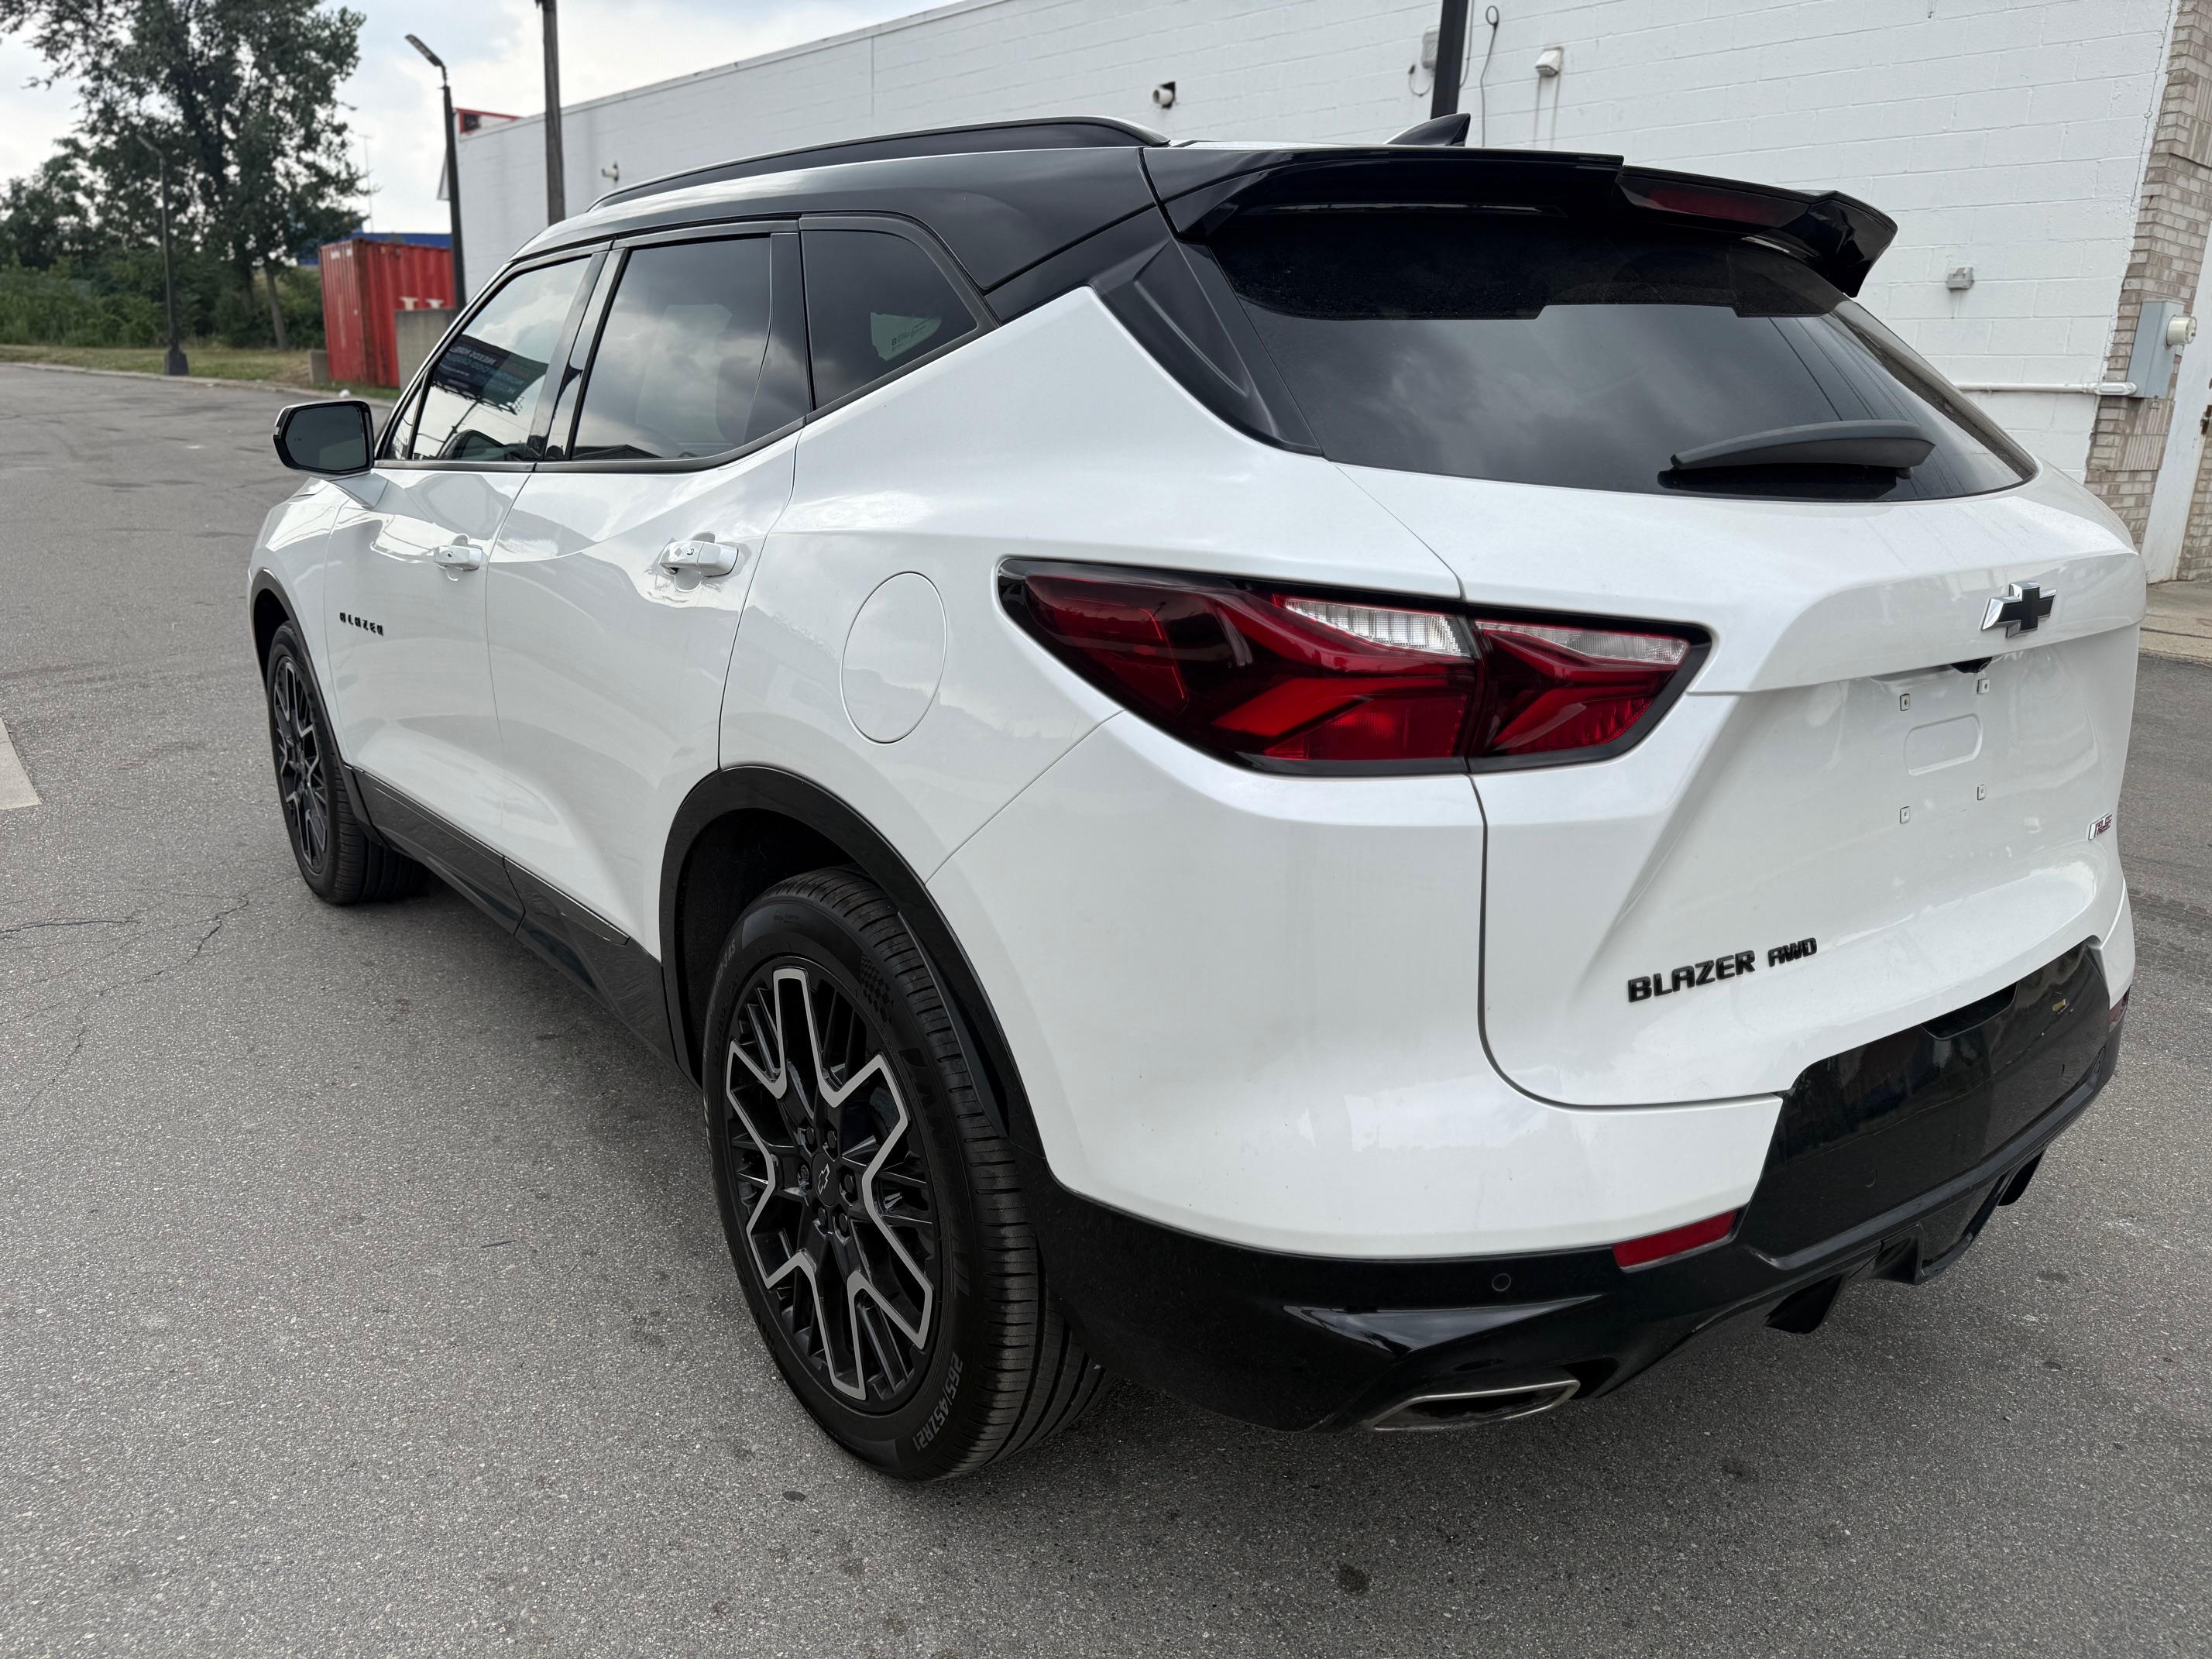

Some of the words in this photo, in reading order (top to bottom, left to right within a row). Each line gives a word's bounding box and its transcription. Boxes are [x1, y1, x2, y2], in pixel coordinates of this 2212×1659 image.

[339, 612, 384, 637] BLAZER
[1627, 950, 1756, 1003] BLAZER
[1767, 937, 1818, 967] AWD
[912, 1350, 963, 1453] 265/45ZR21
